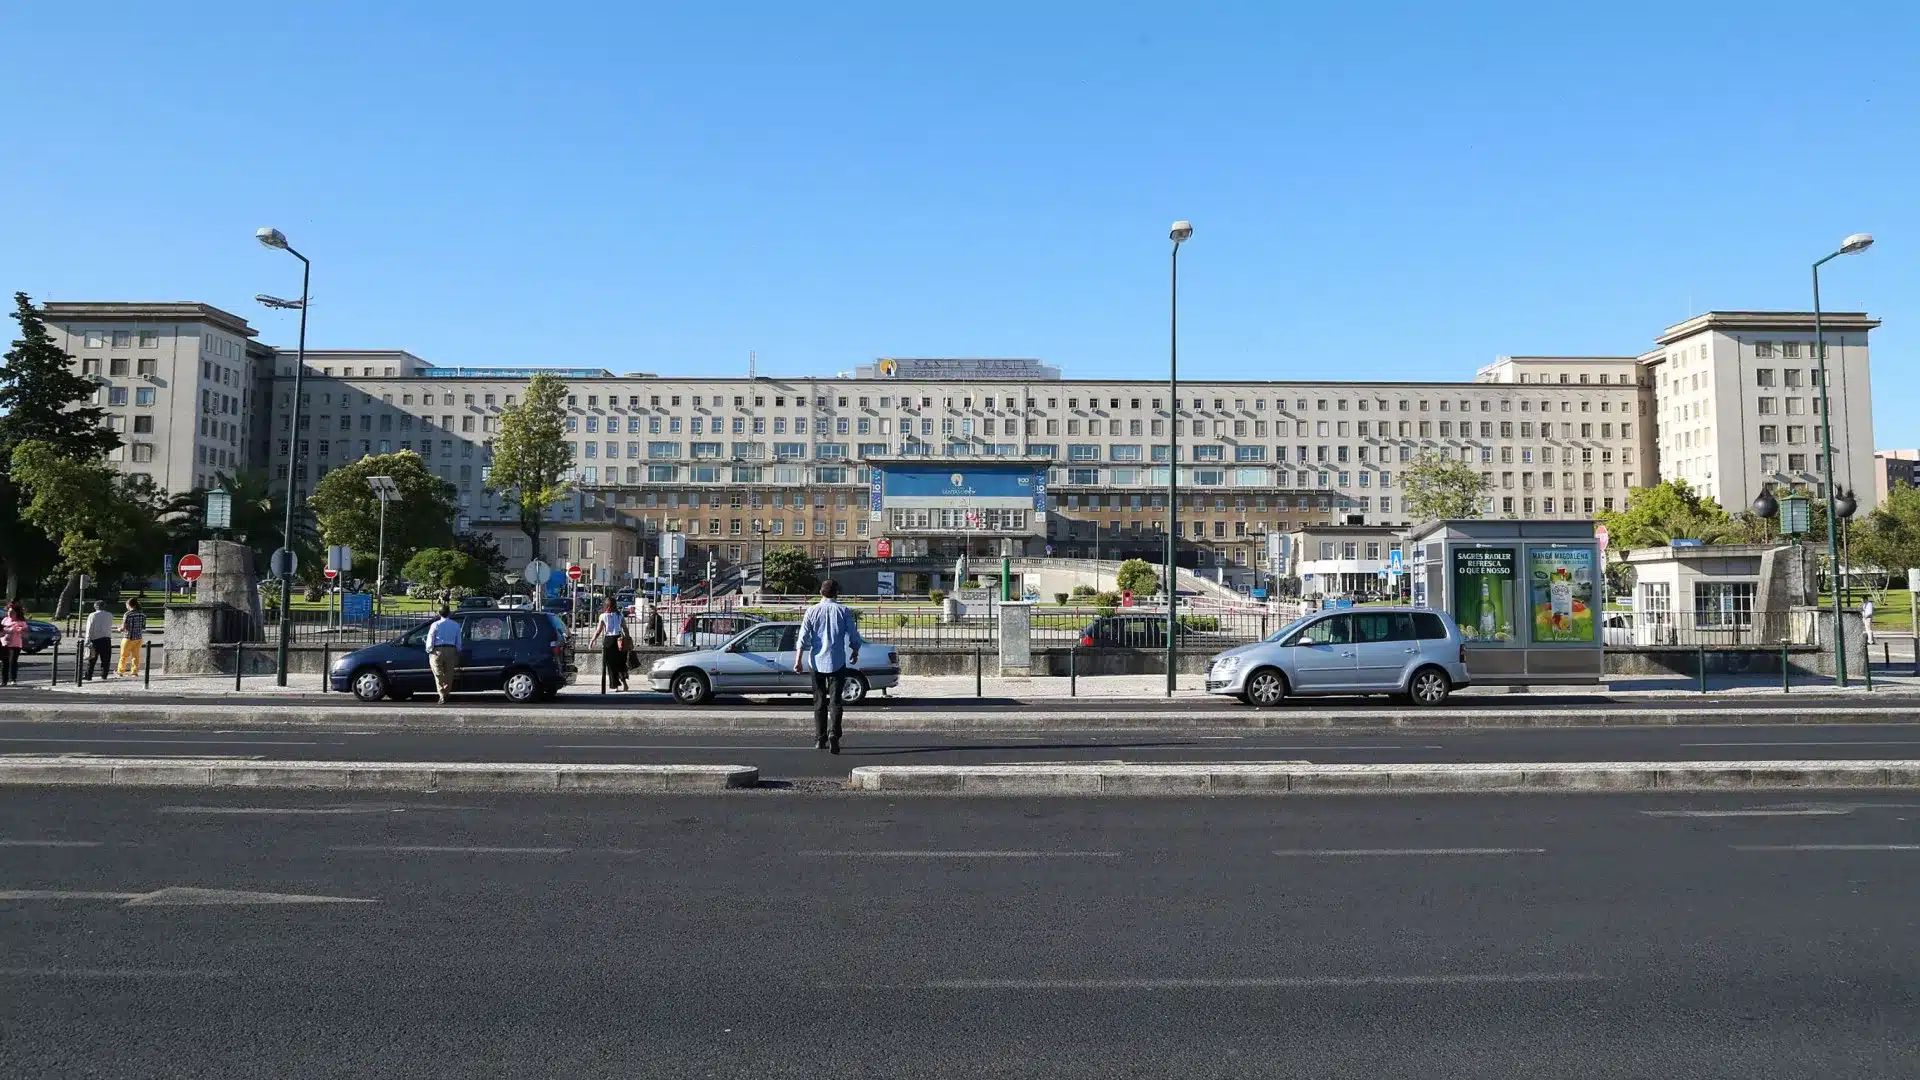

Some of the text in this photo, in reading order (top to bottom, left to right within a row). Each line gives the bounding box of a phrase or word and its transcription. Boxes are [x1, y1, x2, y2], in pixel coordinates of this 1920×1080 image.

[914, 359, 1028, 369] SANTA MARIA
[1466, 567, 1480, 575] QUE
